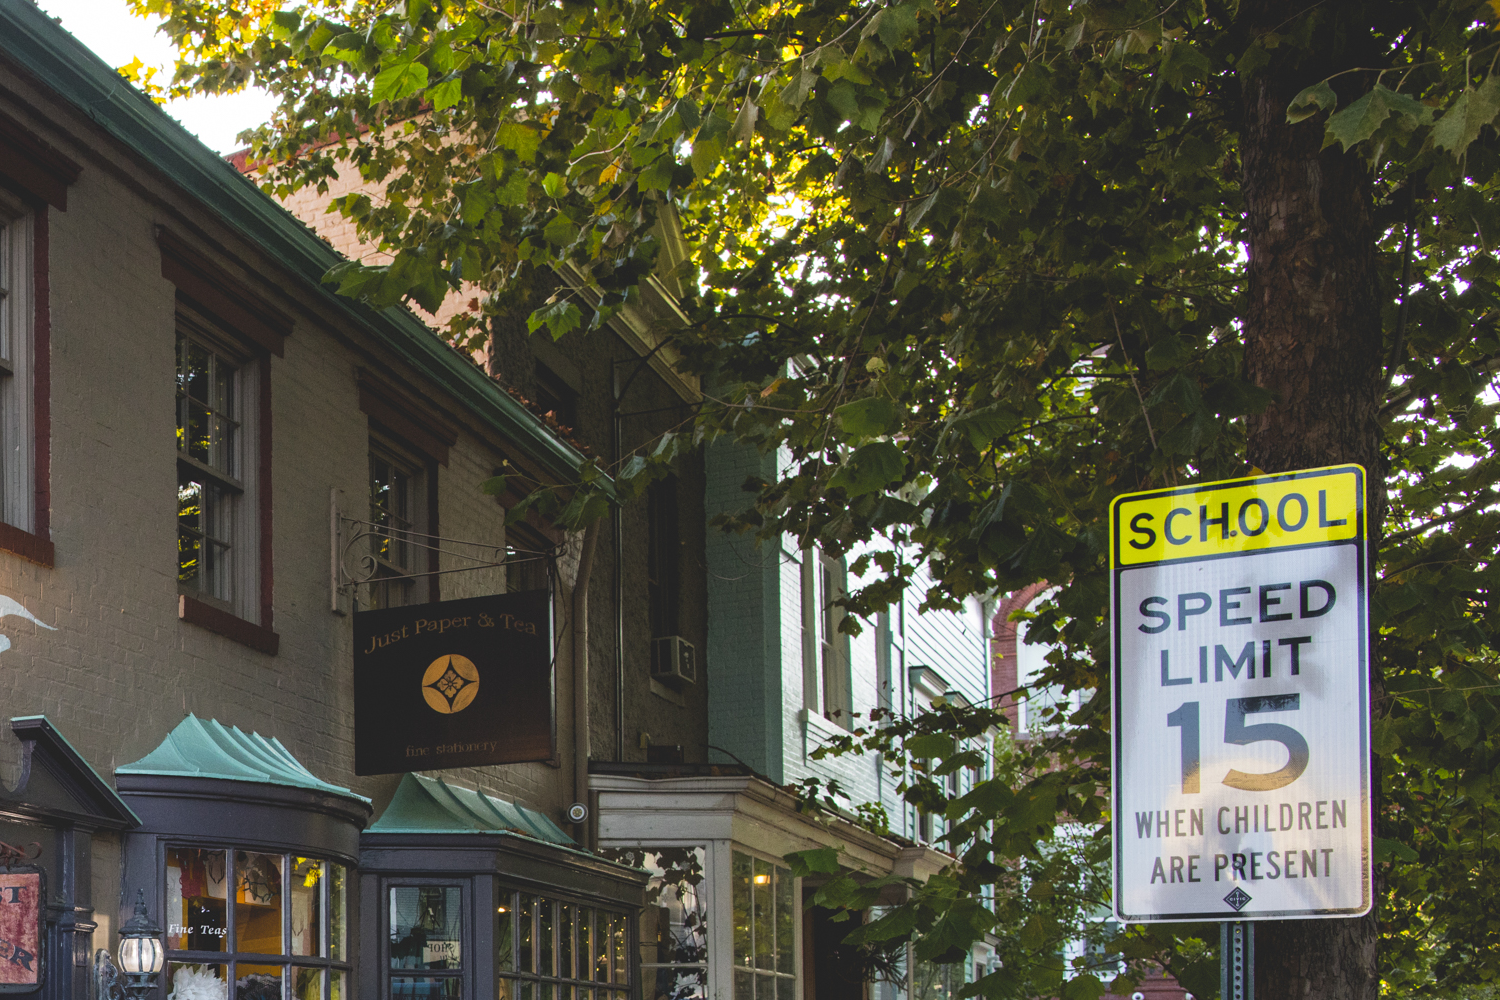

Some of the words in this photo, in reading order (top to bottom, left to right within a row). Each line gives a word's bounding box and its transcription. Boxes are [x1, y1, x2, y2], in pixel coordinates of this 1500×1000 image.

[1128, 489, 1348, 550] SCHOOL
[1138, 579, 1337, 635] SPEED
[364, 625, 409, 655] Just
[414, 615, 472, 635] Paper
[478, 612, 495, 628] &
[500, 613, 539, 636] Tea
[1160, 636, 1312, 687] LIMIT
[405, 745, 430, 758] fine
[436, 740, 498, 755] stationery
[1166, 693, 1310, 795] 15
[1135, 807, 1204, 840] WHEN
[1217, 800, 1347, 835] CHILDREN
[1150, 855, 1201, 885] ARE
[1214, 848, 1334, 882] PRESENT
[168, 923, 194, 934] Fine
[200, 924, 227, 936] Teas
